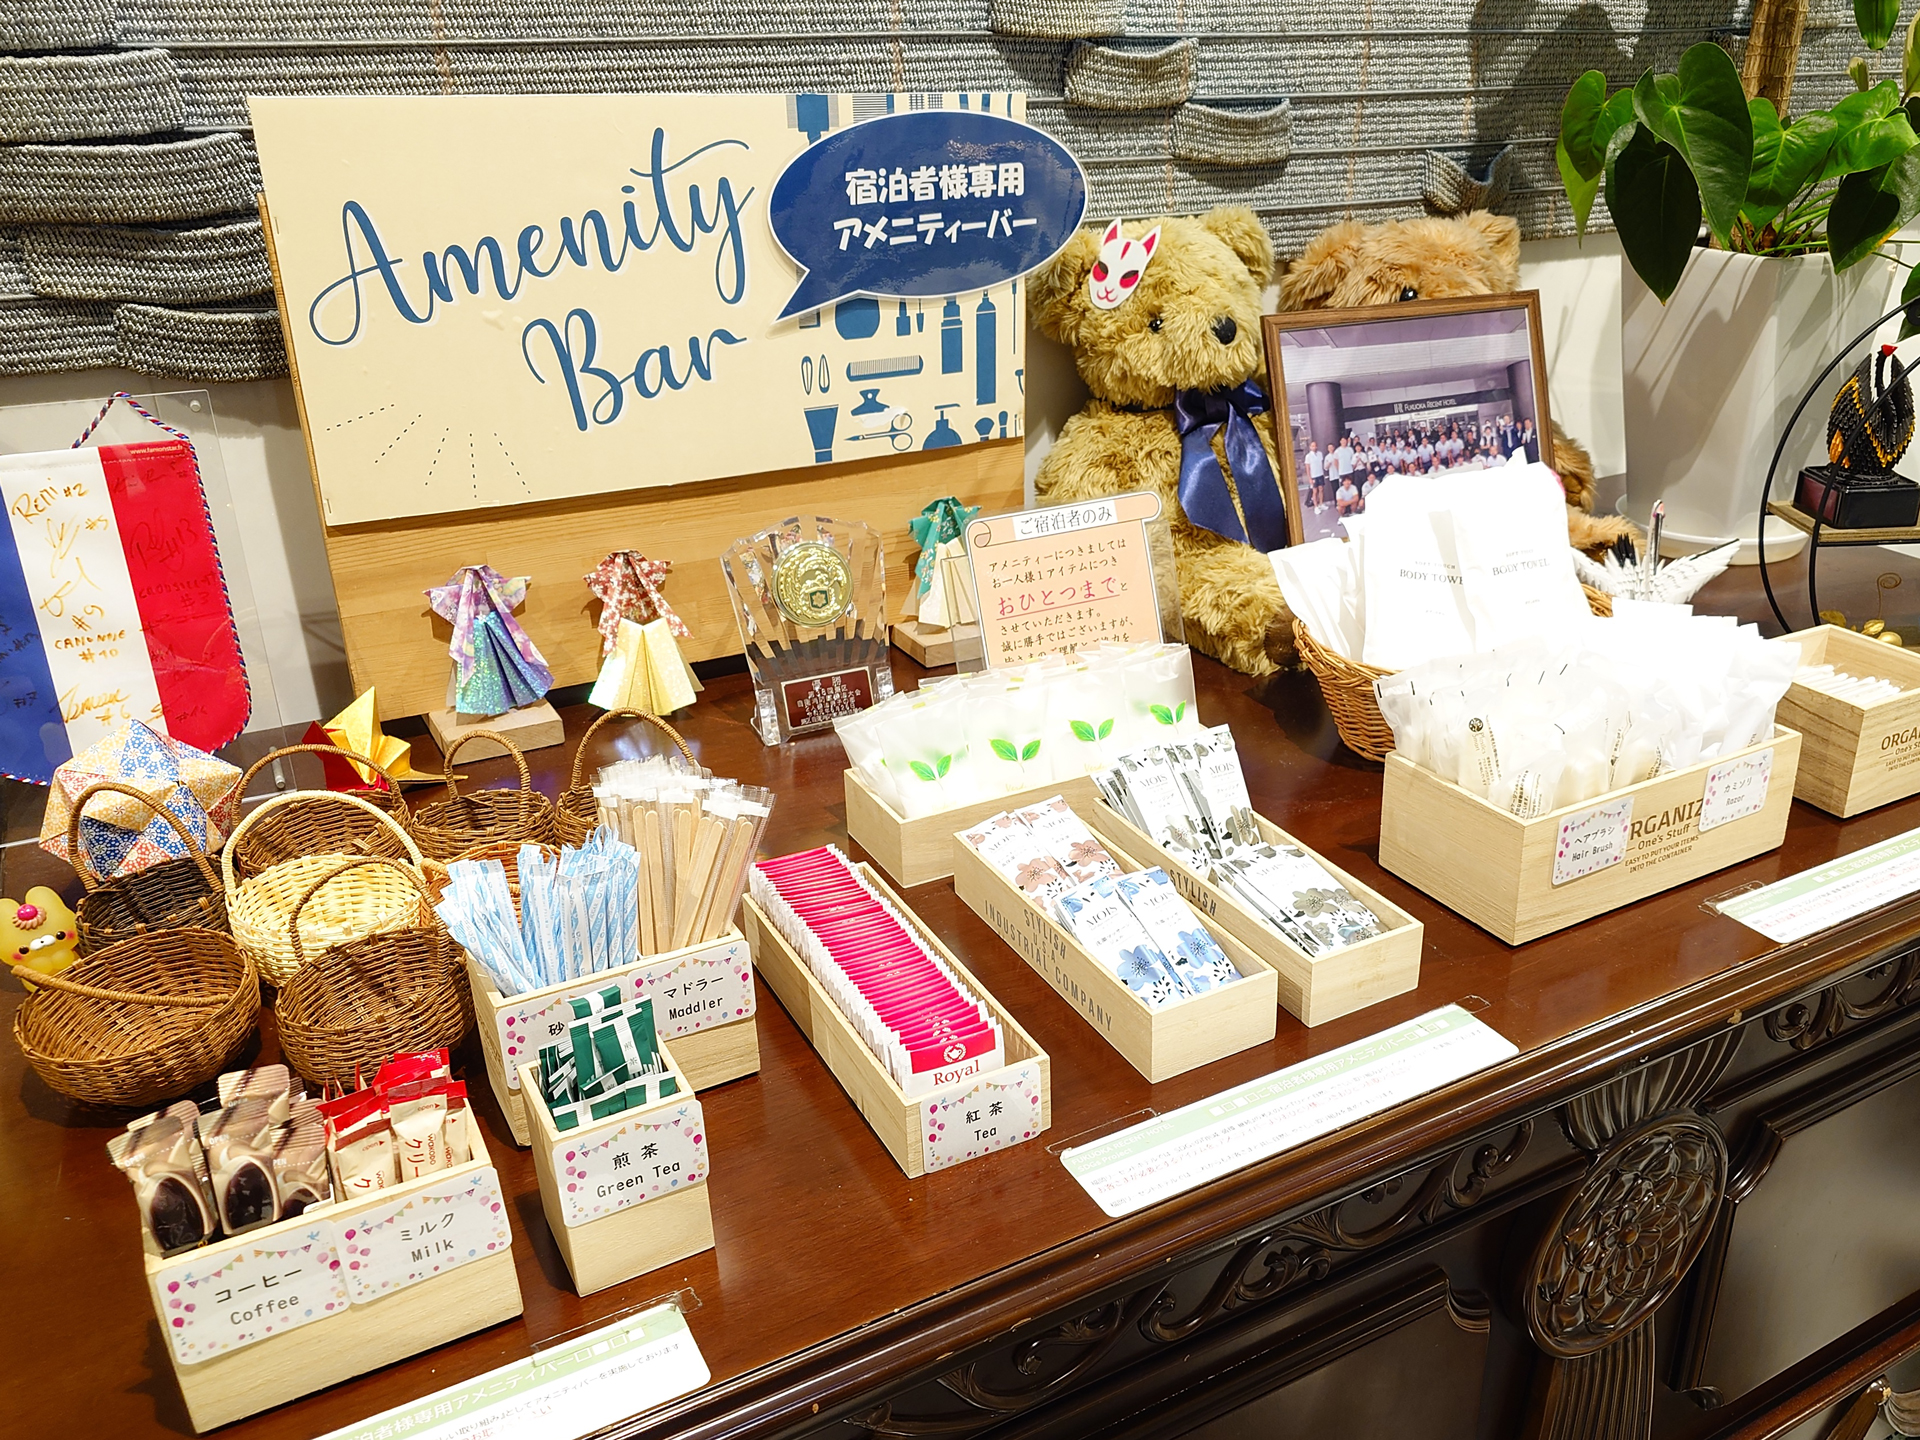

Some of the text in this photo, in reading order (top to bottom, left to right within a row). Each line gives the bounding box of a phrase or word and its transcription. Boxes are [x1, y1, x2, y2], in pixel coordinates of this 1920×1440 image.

[845, 164, 1025, 205] 宿泊者様専用
[309, 127, 754, 346] Amenity
[832, 211, 1038, 252] アメニティーバー
[522, 308, 748, 432] Bar
[1020, 506, 1113, 535] ご宿泊者のみ
[988, 538, 1127, 573] アメニティーにつきましては
[1492, 562, 1519, 576] BODY
[1400, 569, 1429, 581] BODY
[1001, 607, 1101, 636] させていただきます。
[1001, 616, 1134, 652] 誠に勝手ではございますが、
[1881, 727, 1920, 750] ORGA
[1724, 777, 1752, 794] カミソリ
[1726, 794, 1745, 806] Razor
[1574, 826, 1615, 844] ヘアブラシ
[1638, 822, 1691, 850] One's Stuff
[1572, 841, 1613, 862] Hair Brush
[1625, 835, 1699, 867] EASY TO PUT YOUR ITEMS
[1629, 845, 1693, 873] INTO THE CONTAINER
[1169, 869, 1218, 917] STYLISH
[1086, 906, 1118, 926] MOIS
[984, 899, 1049, 973] INDUSTRIAL
[1023, 908, 1068, 960] STYLISH
[663, 976, 725, 999] マドラー
[1054, 966, 1113, 1032] COMPANY
[669, 996, 724, 1021] Maddler
[548, 1022, 566, 1036] 砂
[932, 1060, 981, 1087] Royal
[209, 1133, 230, 1146] OPEN
[974, 1125, 997, 1141] Tea
[1071, 1122, 1175, 1166] FUKUOKA RECENT HOTEL
[124, 1152, 146, 1168] OPEN
[1103, 1147, 1133, 1162] Project
[597, 1161, 681, 1199] Green Tea
[399, 1211, 457, 1242] ミルク
[410, 1240, 455, 1264] Milk
[214, 1268, 303, 1305] コーヒー
[229, 1292, 300, 1327] Coffee
